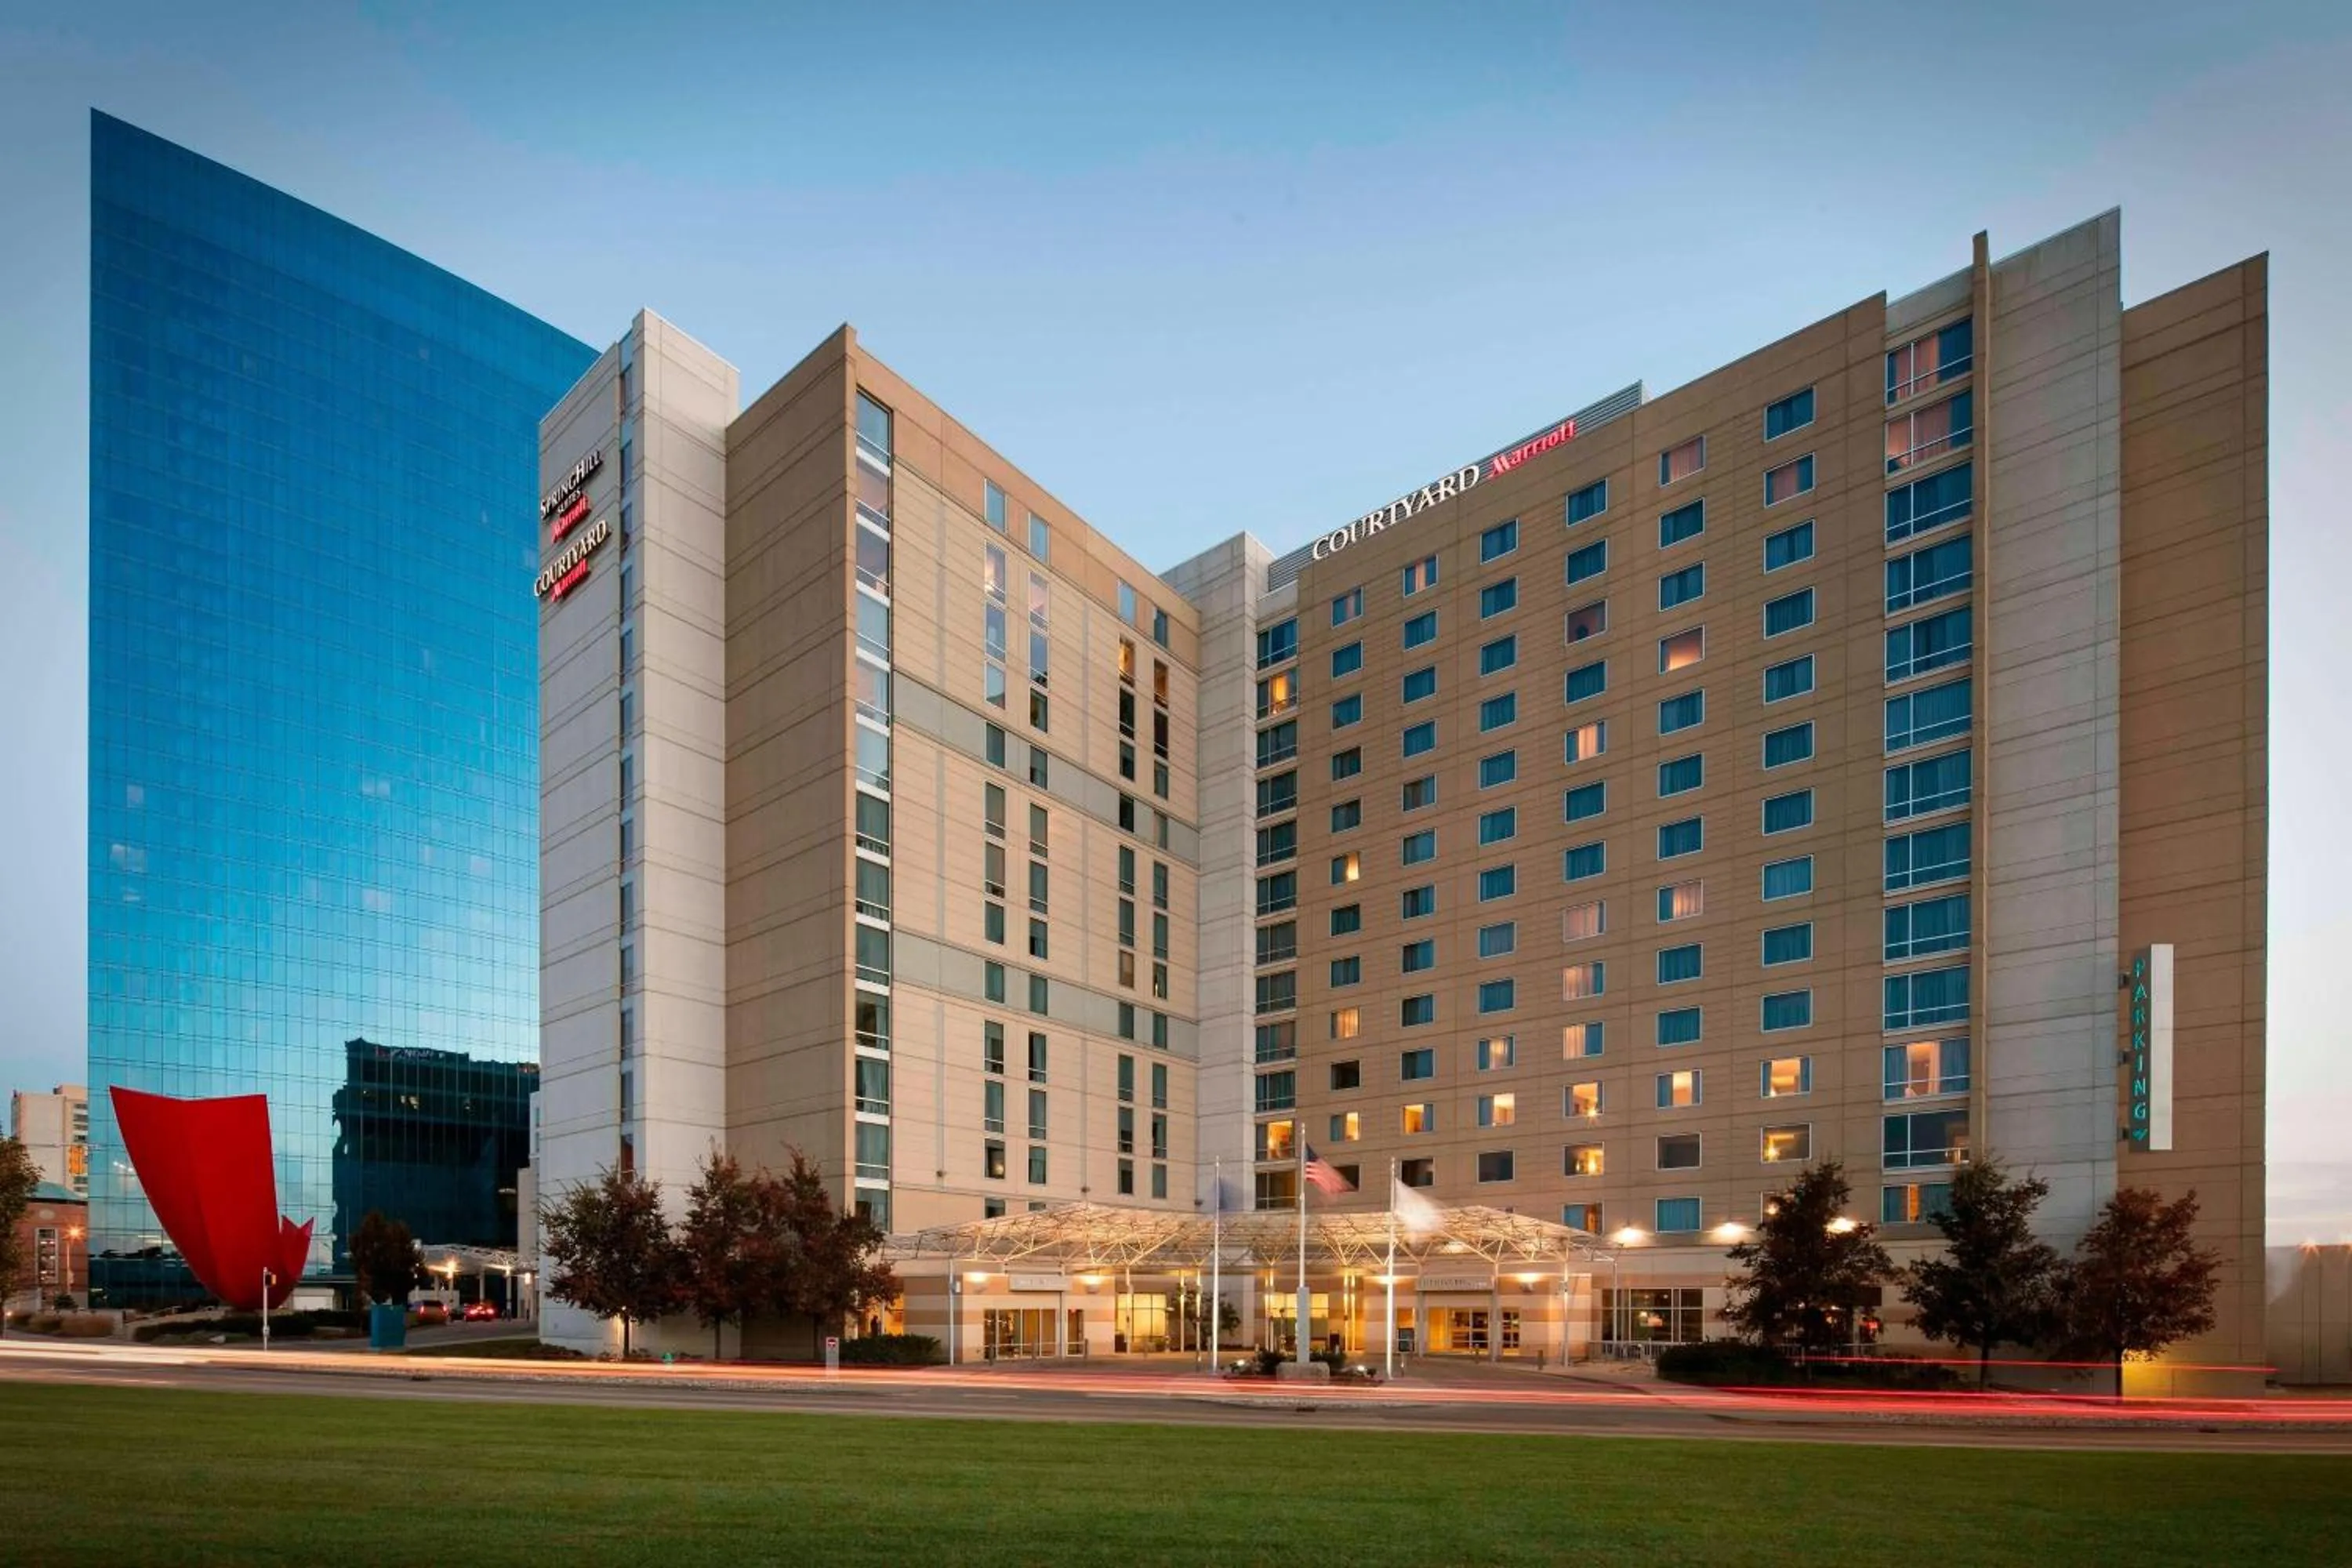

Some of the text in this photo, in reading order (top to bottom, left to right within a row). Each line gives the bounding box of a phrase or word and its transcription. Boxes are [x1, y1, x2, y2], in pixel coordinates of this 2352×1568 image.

[534, 520, 608, 597] COURTYARD
[1312, 419, 1576, 561] COURTYARD Marriott
[2132, 956, 2147, 1120] PARKING
